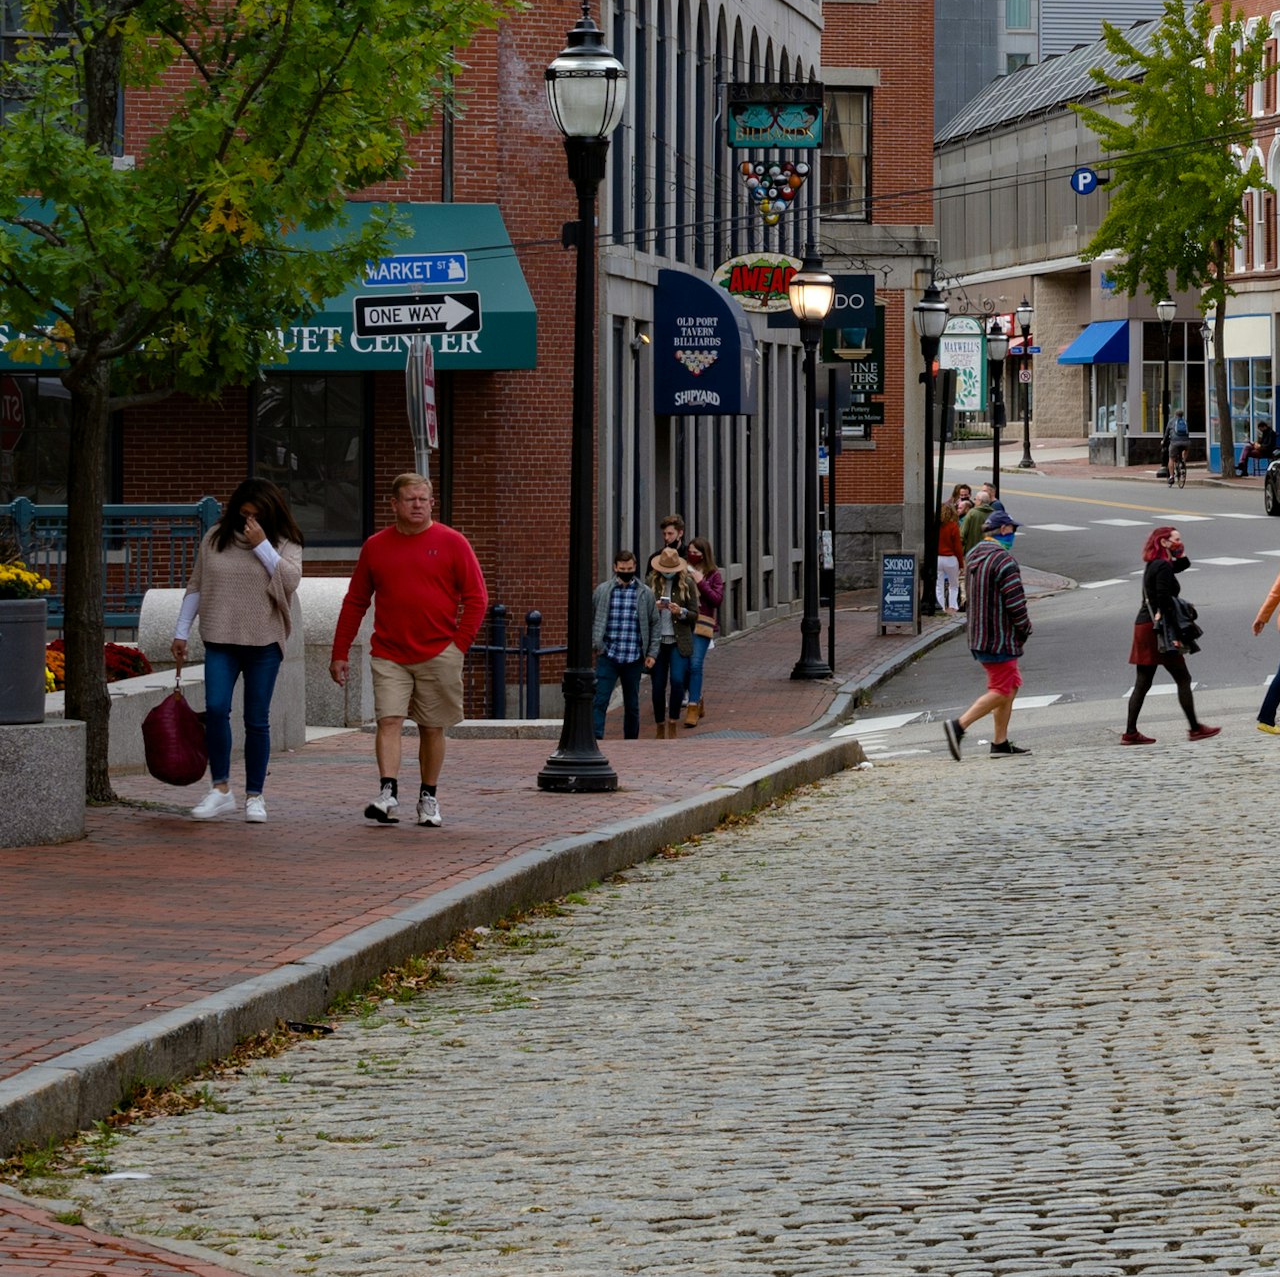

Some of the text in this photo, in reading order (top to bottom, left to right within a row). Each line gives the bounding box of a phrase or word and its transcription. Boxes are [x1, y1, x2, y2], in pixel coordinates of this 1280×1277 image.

[735, 127, 814, 142] BILLIARDS
[1078, 172, 1092, 191] P
[366, 261, 446, 281] MARKET ST
[369, 306, 442, 324] ONE WAY
[676, 317, 718, 326] OLD PORT
[681, 327, 714, 336] TAVERN
[673, 337, 721, 346] BILLIARDS
[944, 341, 980, 353] MAXWELL'S
[674, 390, 720, 406] SHIPYARD
[884, 558, 914, 570] SKORDO
